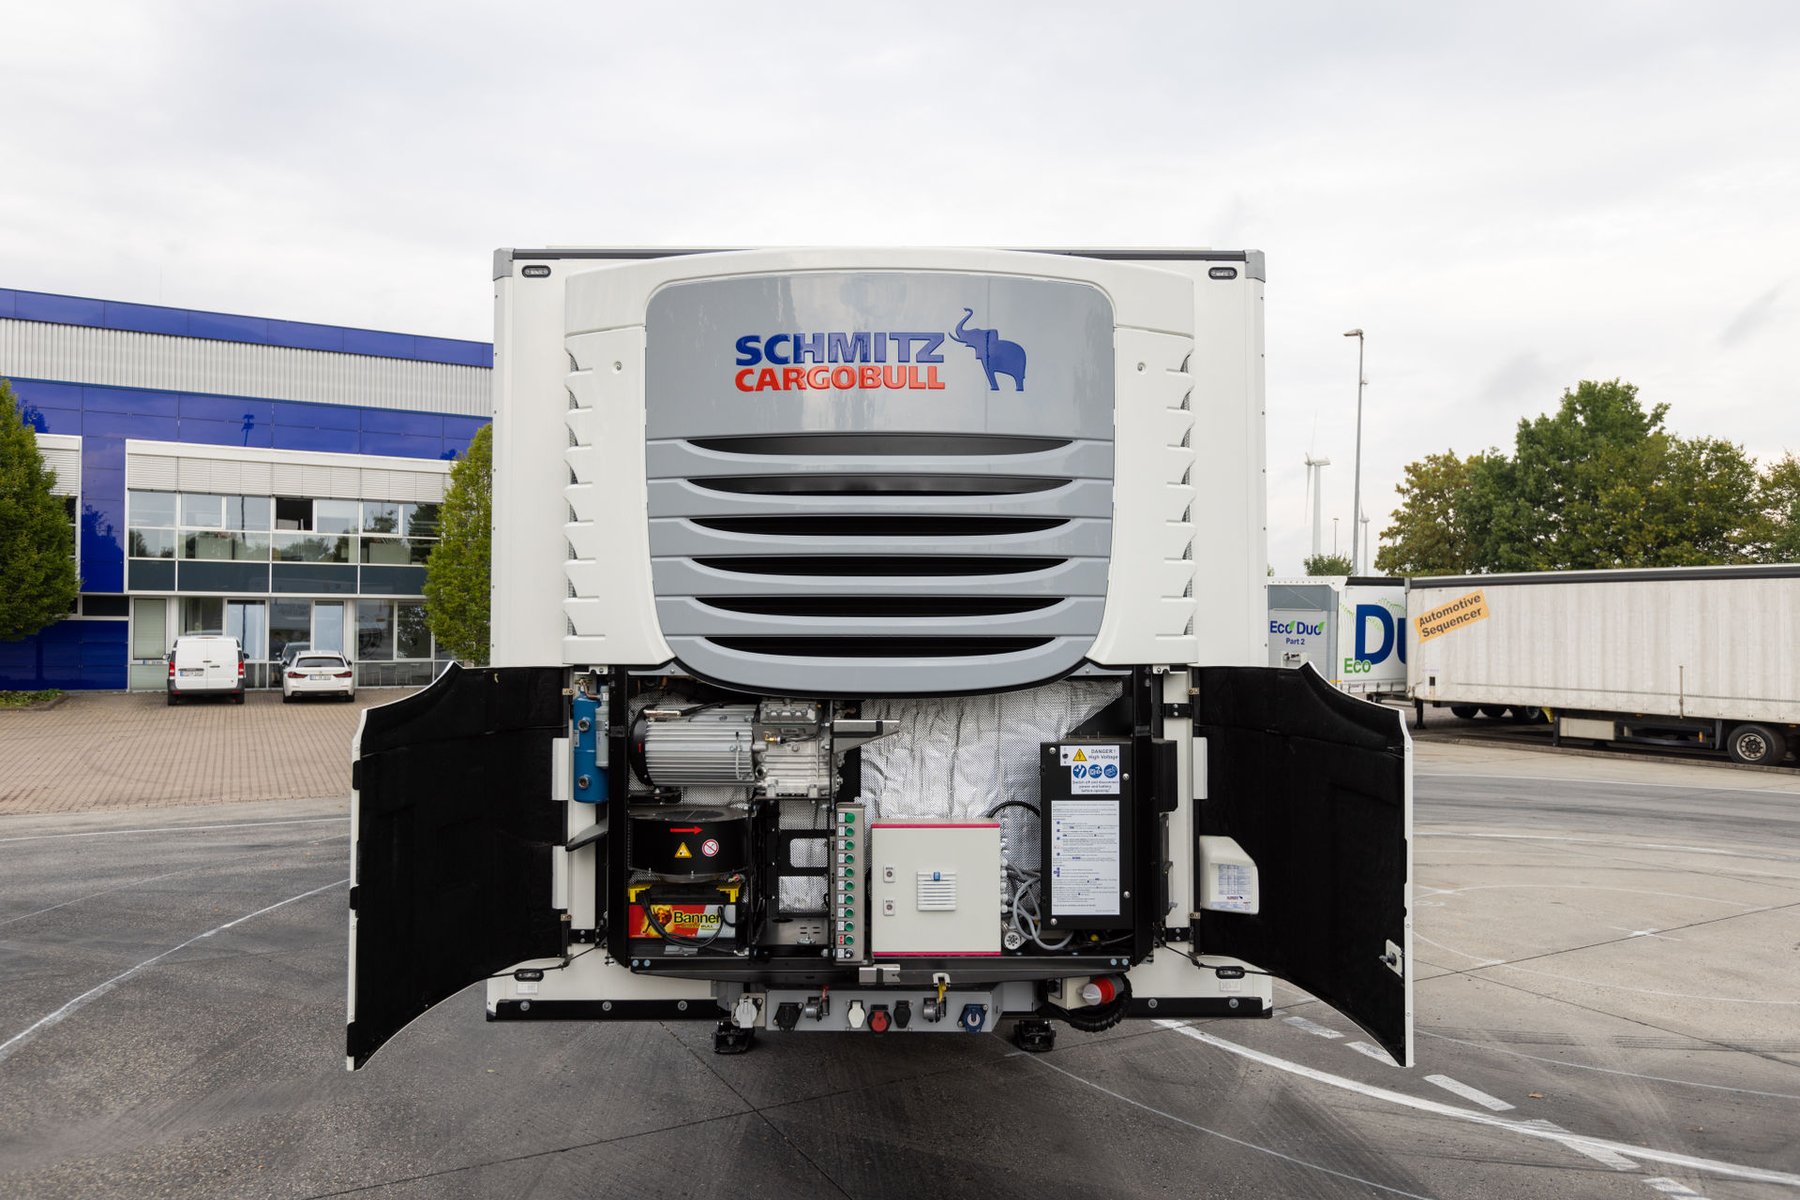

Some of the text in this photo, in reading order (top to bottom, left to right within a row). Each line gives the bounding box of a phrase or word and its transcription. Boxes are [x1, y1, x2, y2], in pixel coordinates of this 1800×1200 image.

[735, 332, 944, 365] SCHMITZ
[735, 366, 945, 391] CARGOBULL
[1419, 594, 1481, 628] Automotive
[1269, 620, 1295, 634] Eco
[1421, 607, 1482, 638] Sequencer
[1285, 637, 1299, 645] Part
[1343, 658, 1371, 673] Eco
[674, 911, 720, 923] Banner
